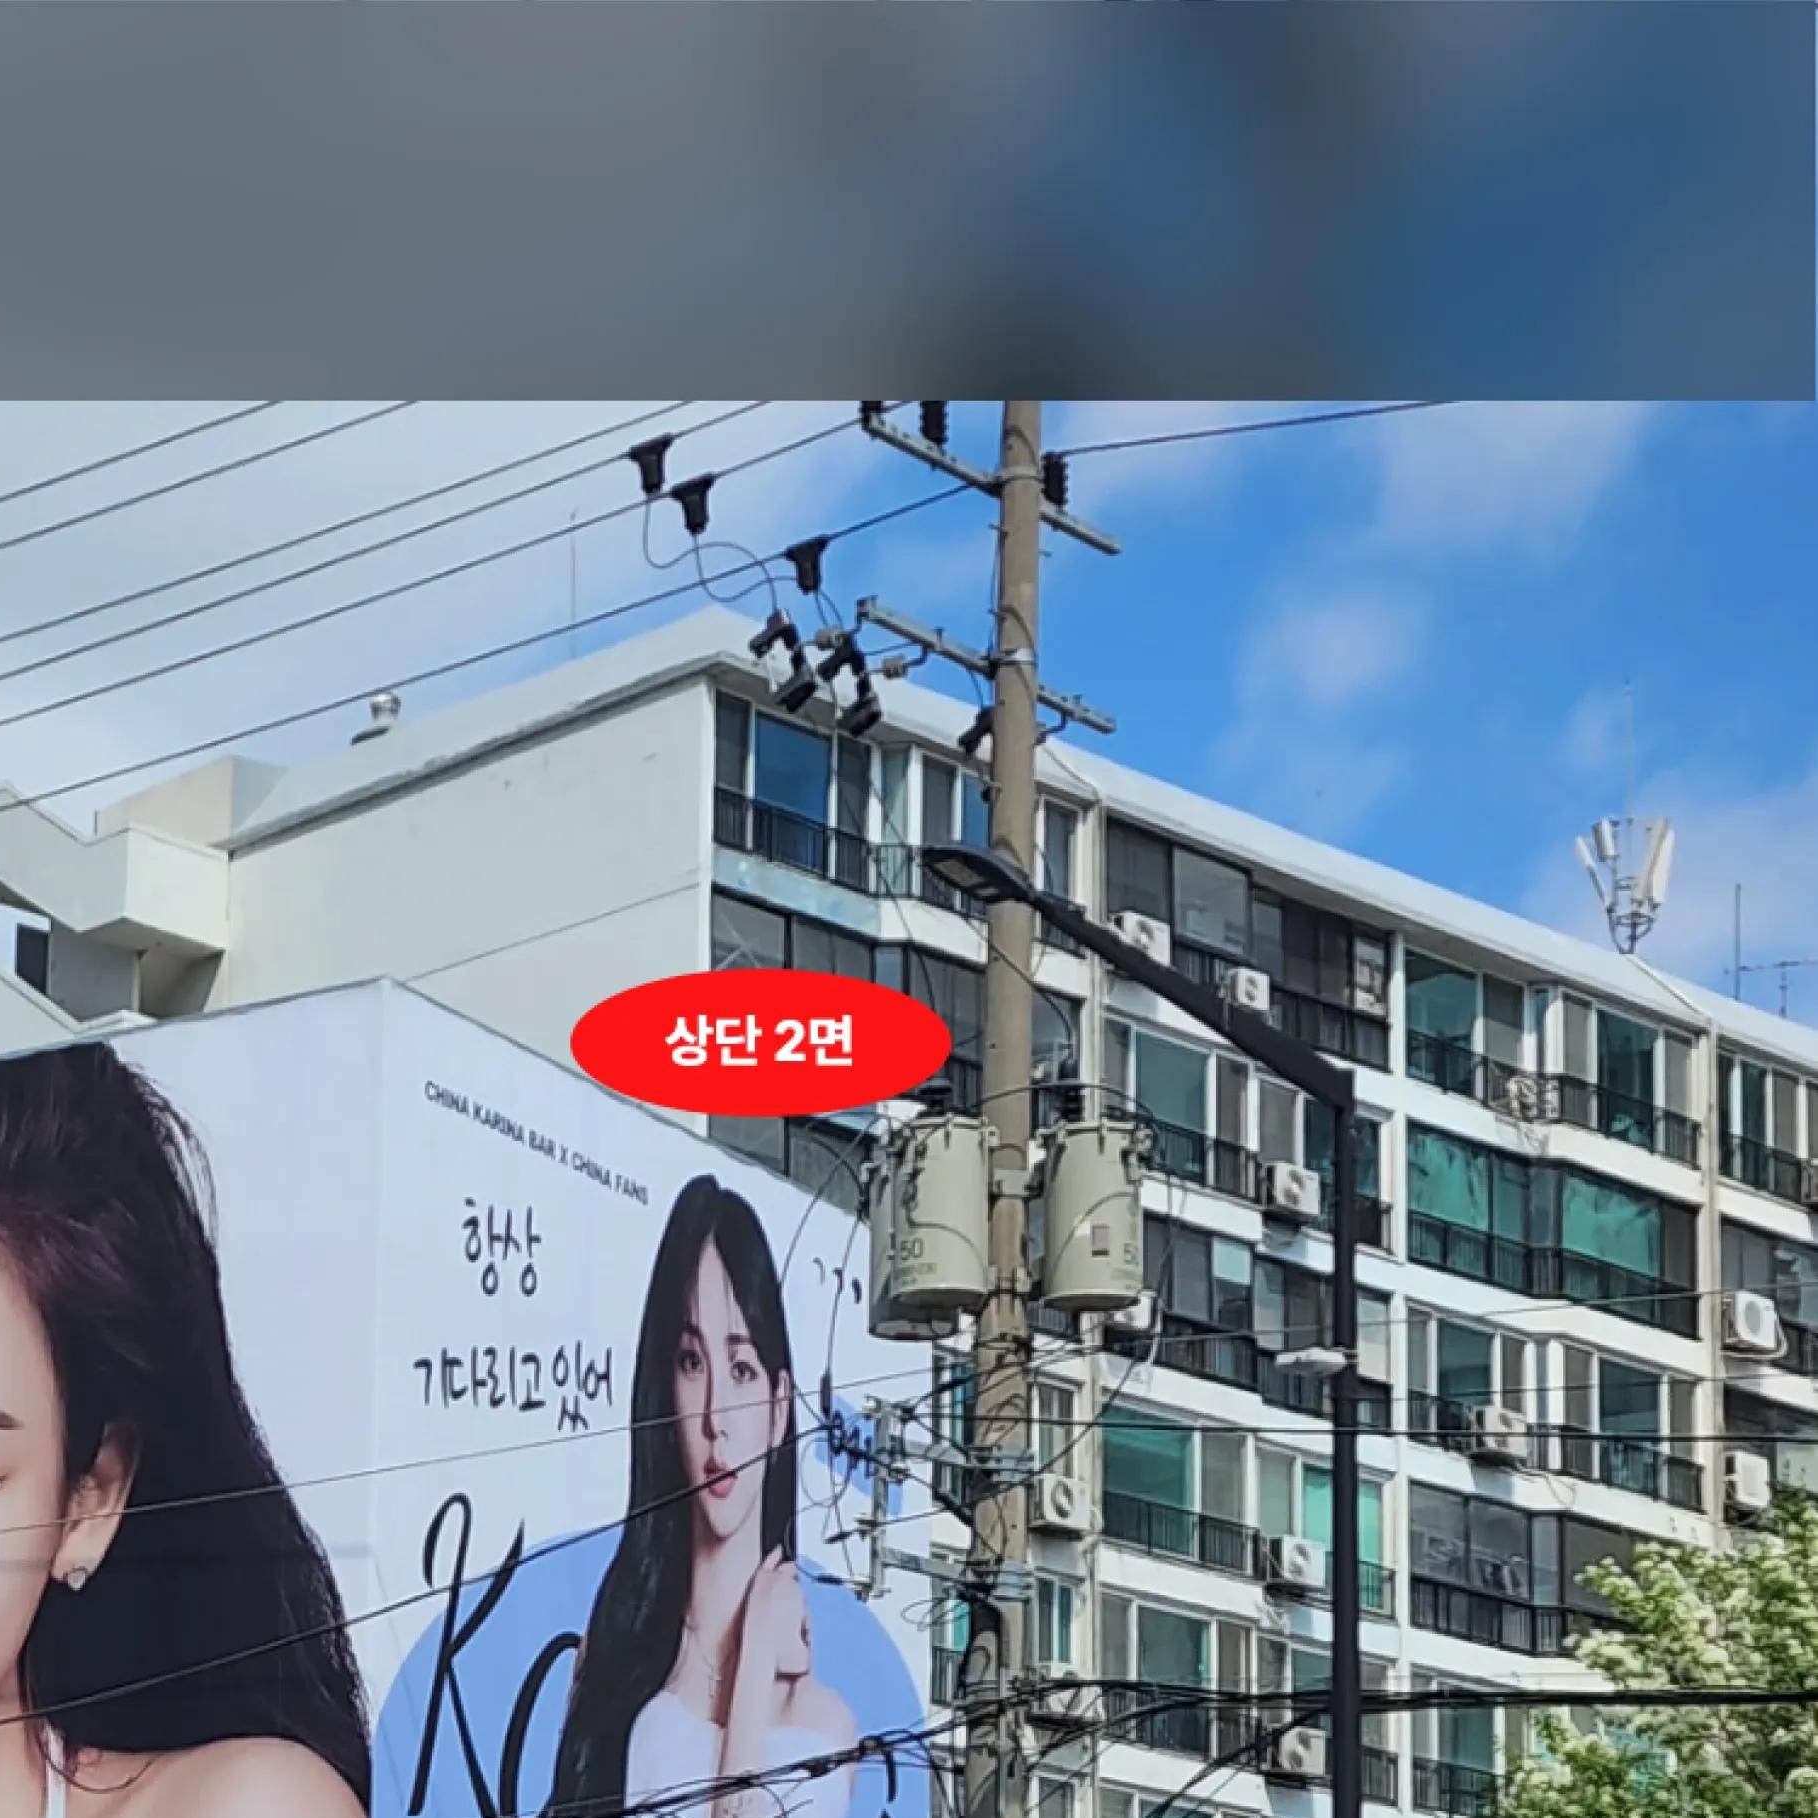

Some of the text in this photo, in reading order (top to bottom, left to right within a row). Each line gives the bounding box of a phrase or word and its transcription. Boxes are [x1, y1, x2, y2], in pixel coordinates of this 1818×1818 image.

[424, 1080, 470, 1117] CHINA
[473, 1101, 525, 1145] KARINA
[529, 1128, 556, 1160] BAR
[573, 1151, 612, 1190] CHINA
[615, 1174, 649, 1206] FANS
[462, 1197, 542, 1298] 항상
